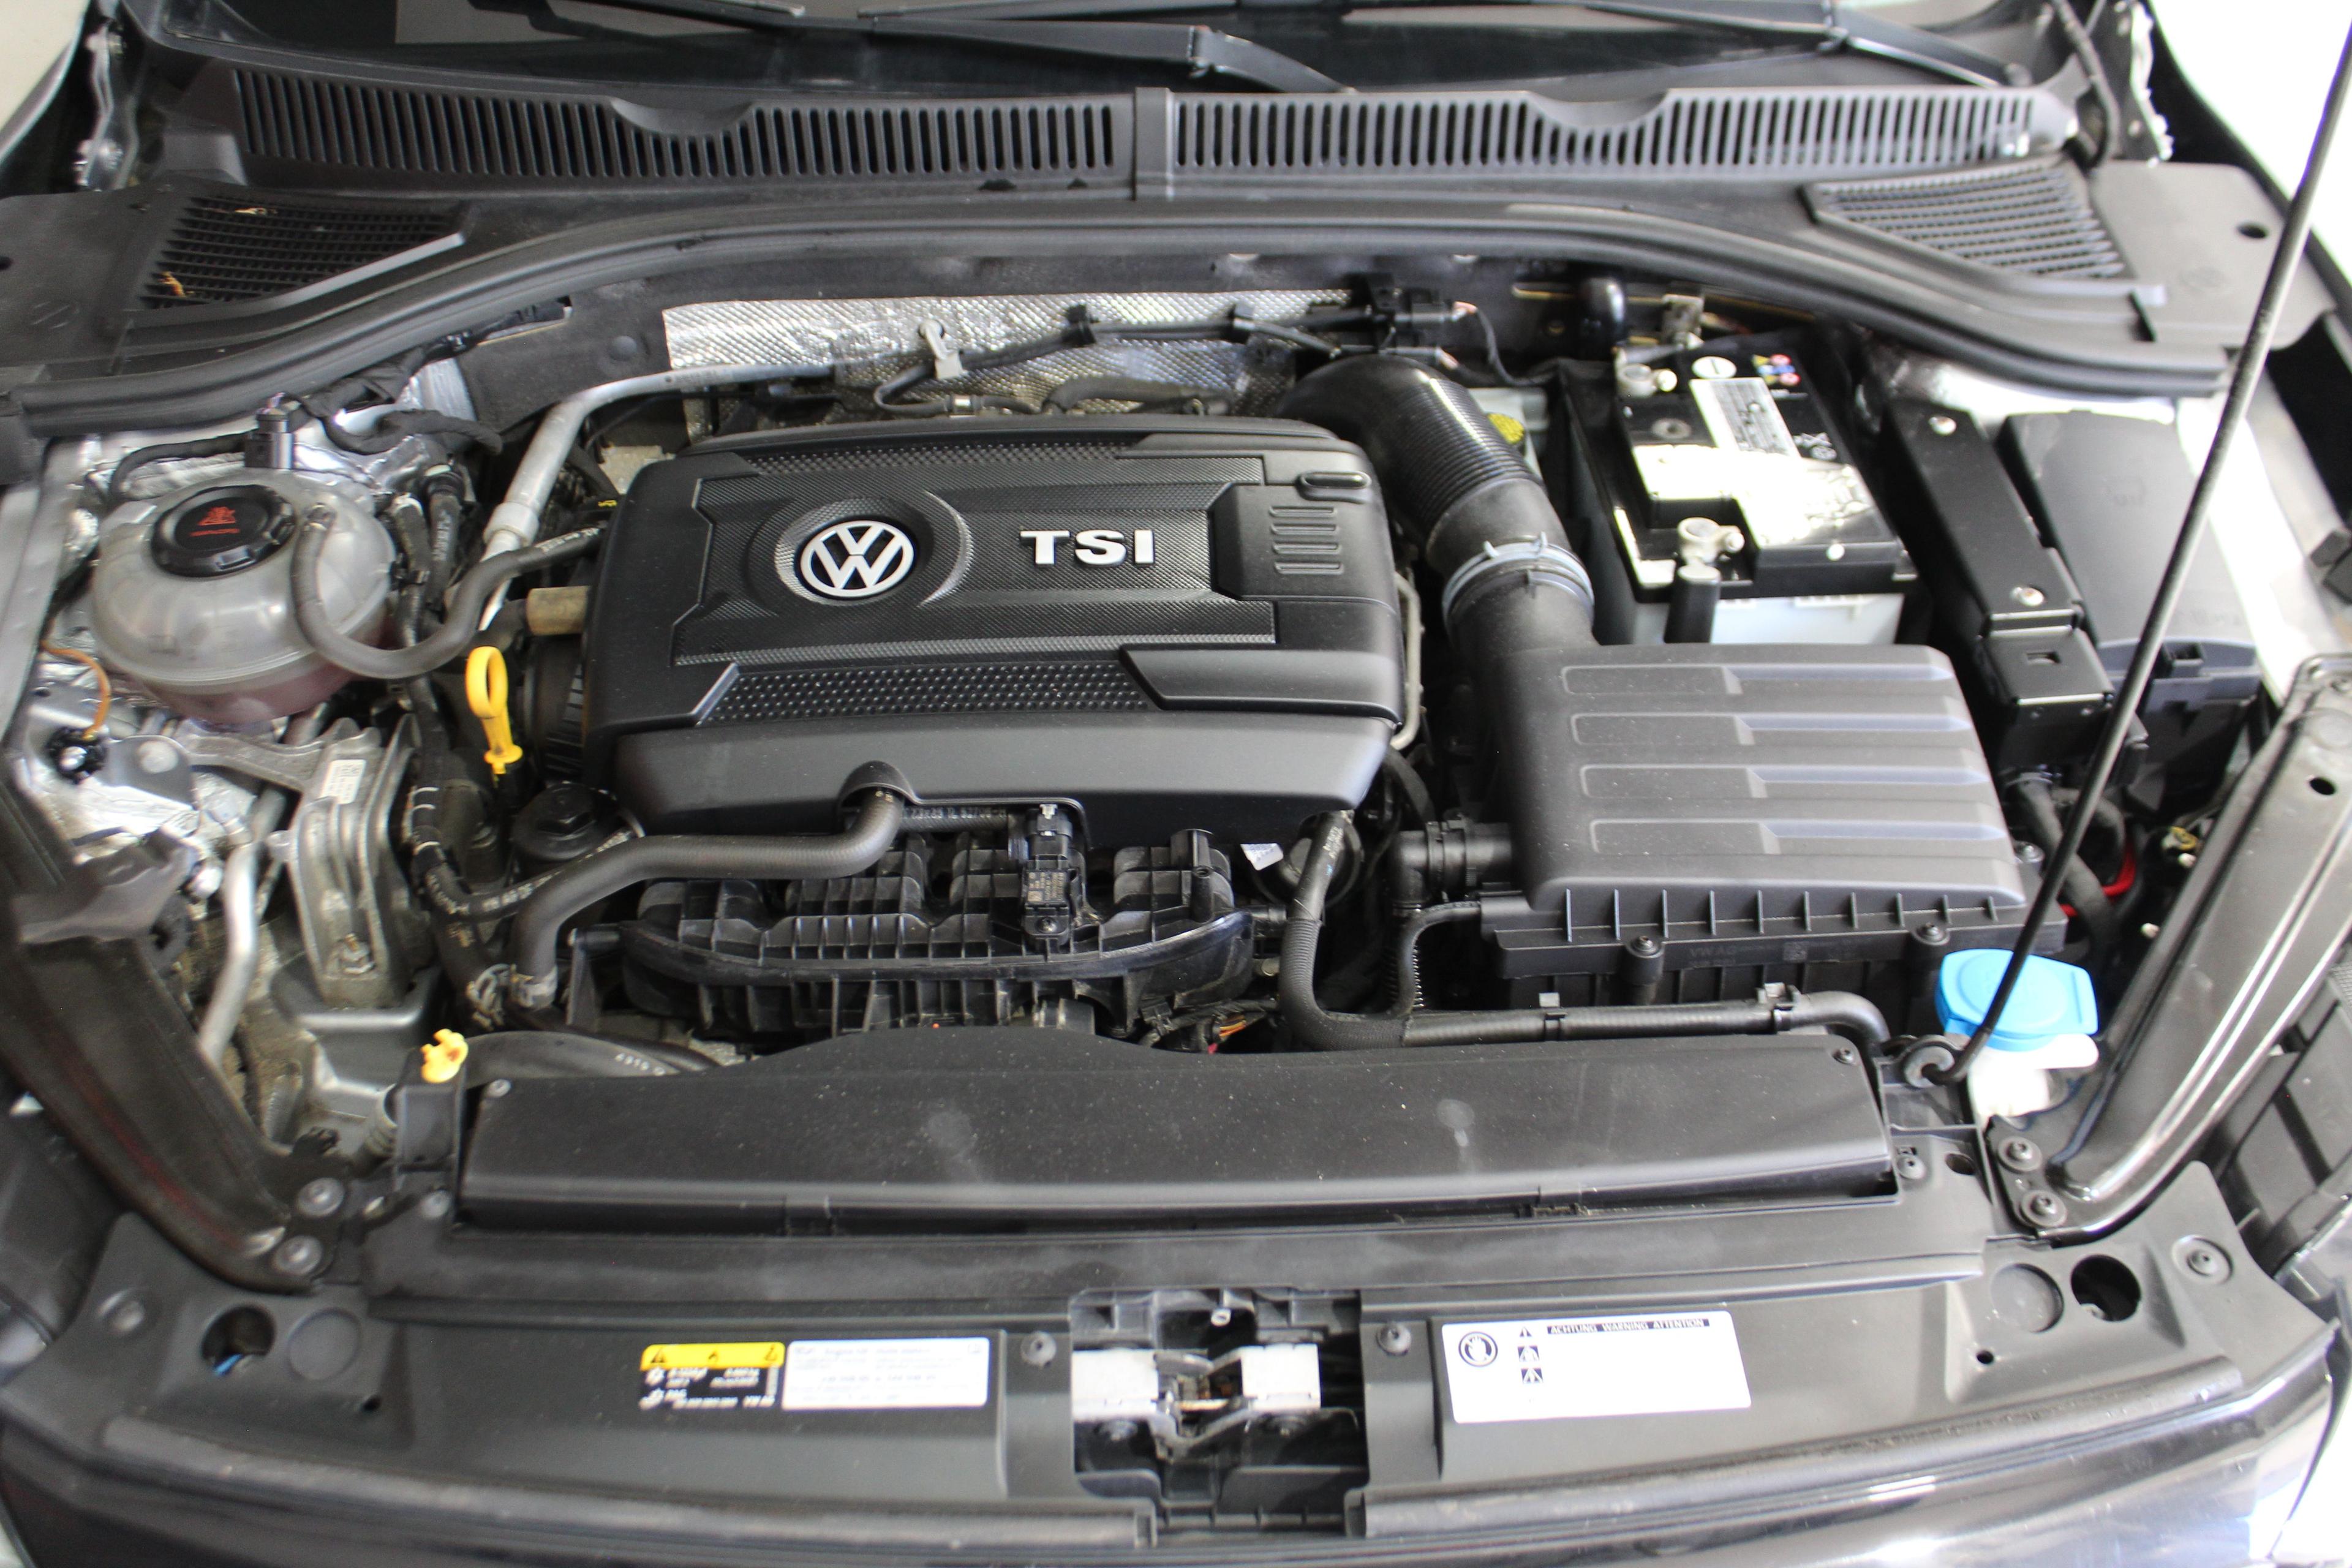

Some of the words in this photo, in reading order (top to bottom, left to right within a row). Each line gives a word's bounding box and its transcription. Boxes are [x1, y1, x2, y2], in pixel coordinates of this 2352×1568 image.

[1020, 529, 1154, 565] TSI
[1550, 1324, 1598, 1334] ACHTUNG
[1601, 1321, 1649, 1332] WARNING
[1653, 1319, 1705, 1330] ATTENTION
